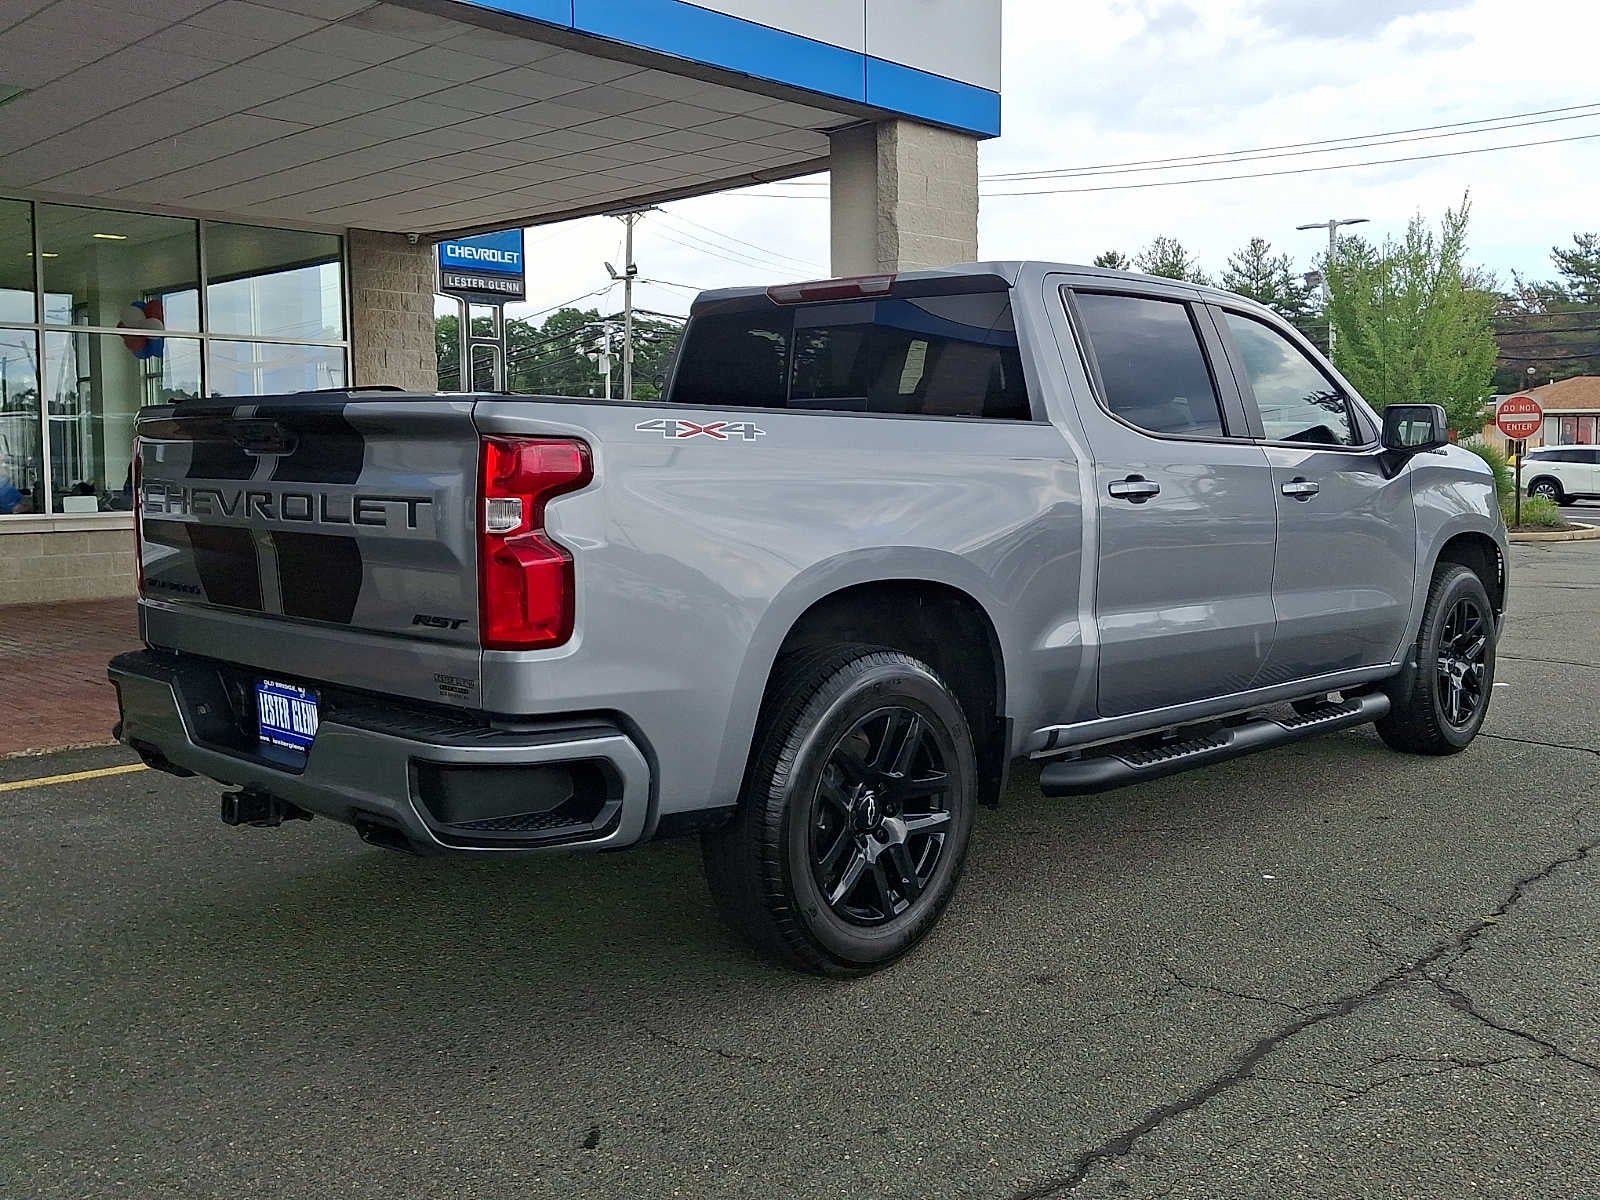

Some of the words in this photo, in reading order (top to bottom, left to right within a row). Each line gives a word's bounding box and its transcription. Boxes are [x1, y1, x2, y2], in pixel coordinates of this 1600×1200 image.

[447, 245, 519, 264] CHEVROLET
[448, 276, 485, 289] LESTER
[488, 281, 520, 292] GLENN
[1519, 404, 1536, 412] NOT
[1506, 423, 1533, 431] ENTER
[143, 483, 433, 530] CHEVROLET
[412, 614, 469, 630] RST
[260, 692, 291, 730] LESTER
[291, 699, 319, 736] GLENN
